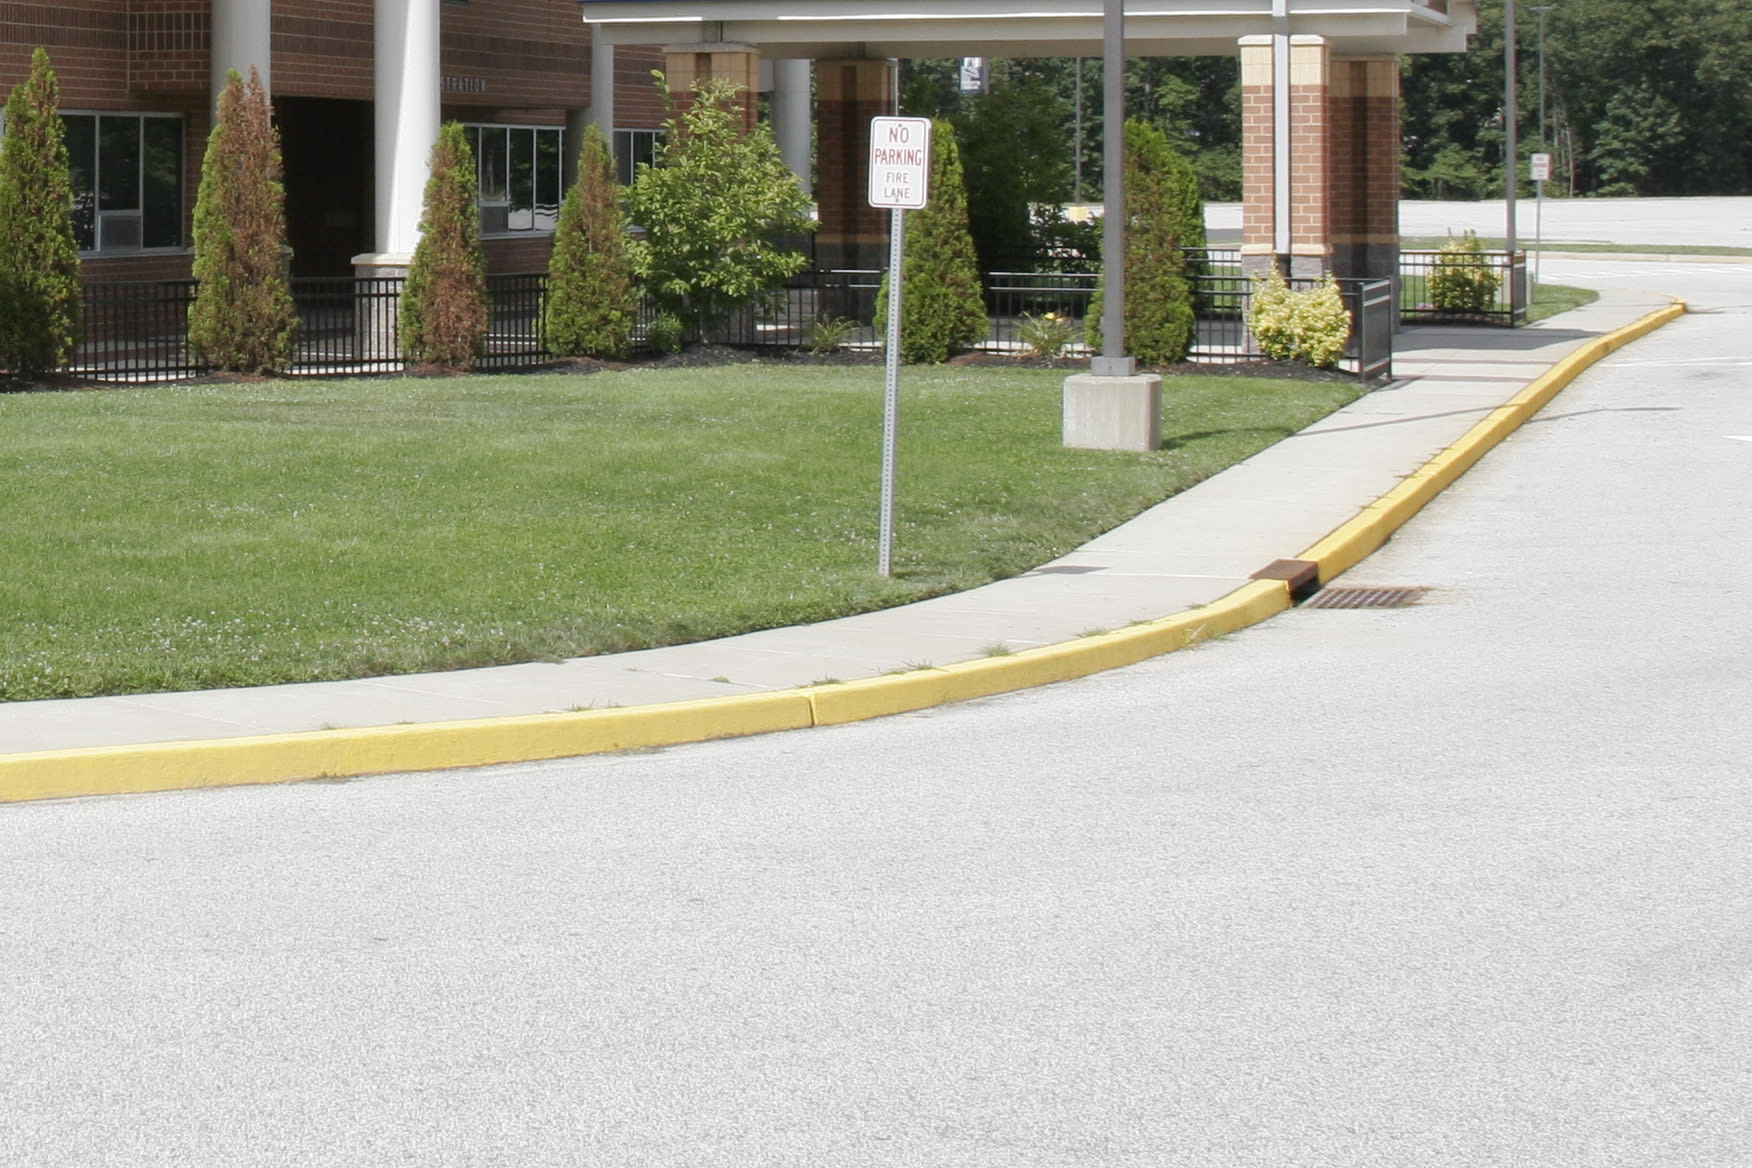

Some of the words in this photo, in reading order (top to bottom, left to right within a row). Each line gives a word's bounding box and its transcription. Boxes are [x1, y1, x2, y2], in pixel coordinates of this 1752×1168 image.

[889, 127, 909, 143] NO
[874, 148, 922, 166] PARKING
[886, 172, 909, 184] FIRE
[884, 188, 910, 199] LANE
